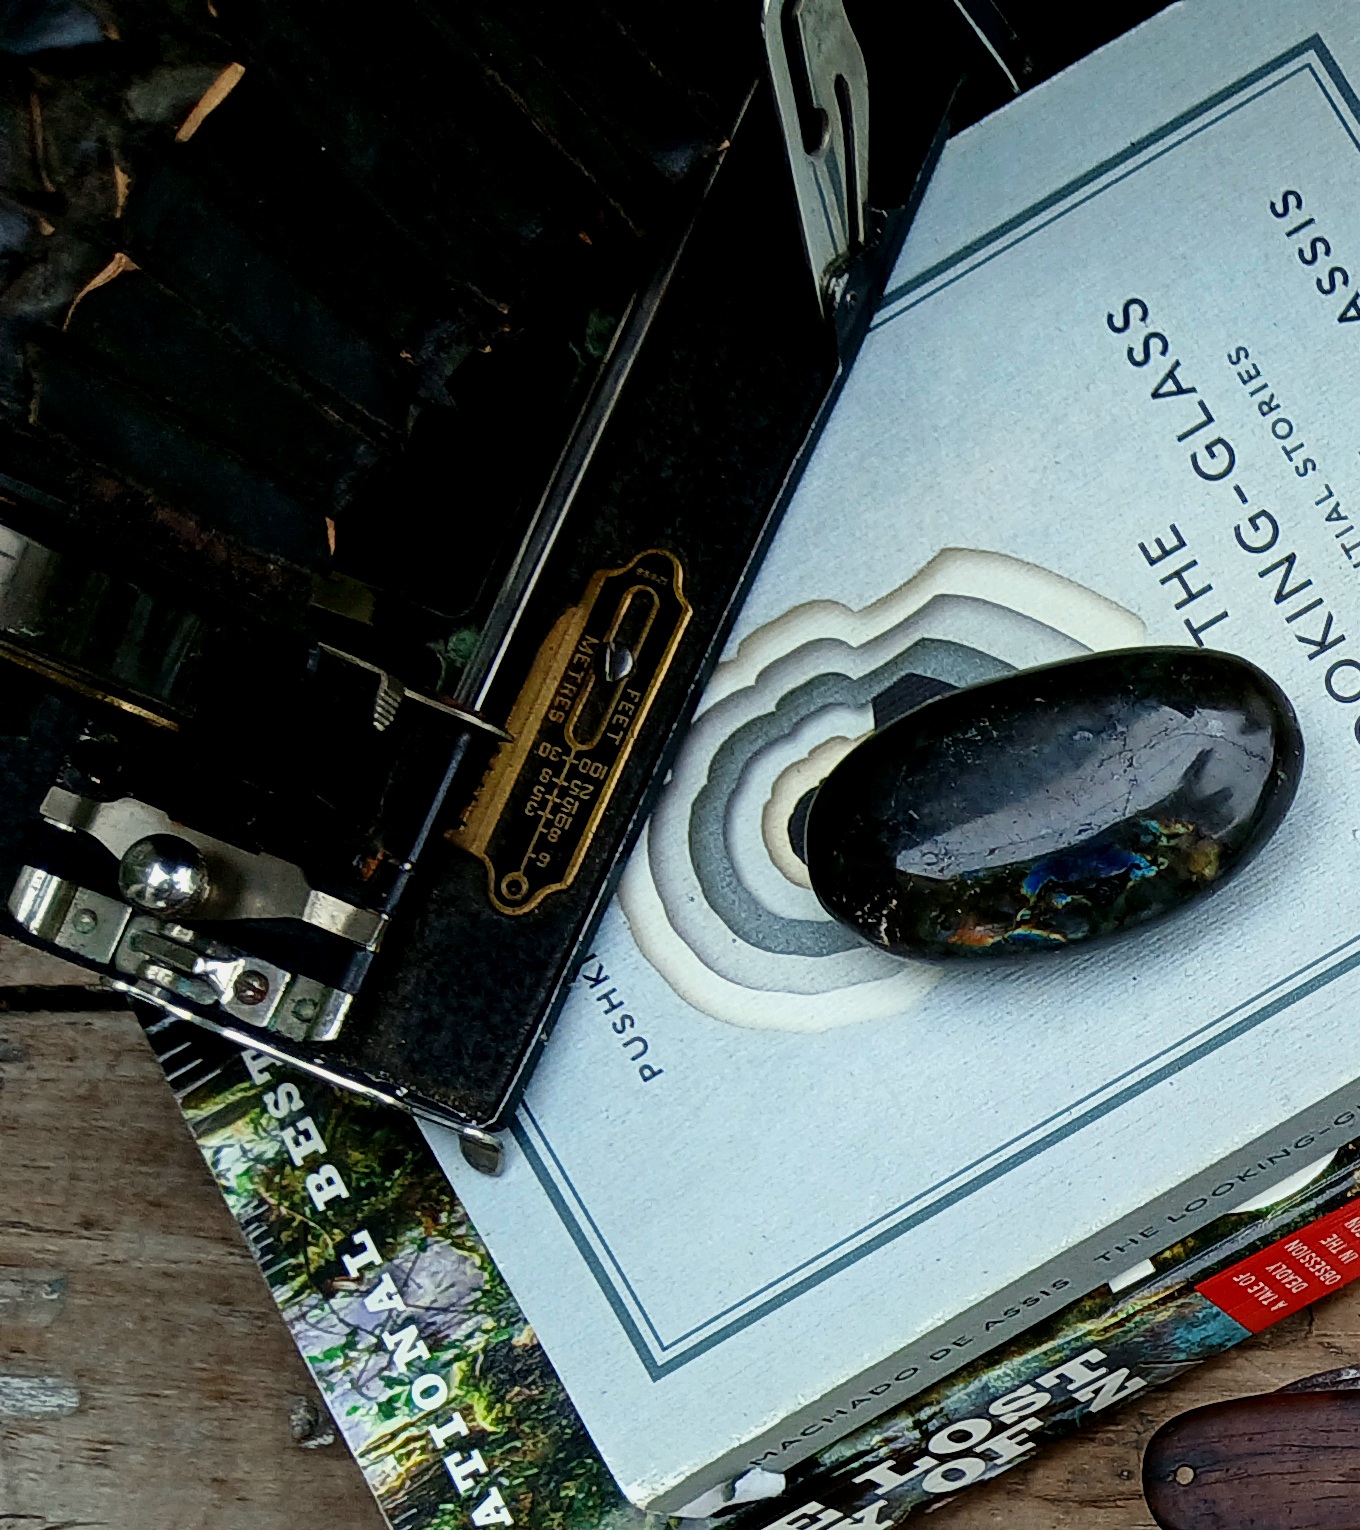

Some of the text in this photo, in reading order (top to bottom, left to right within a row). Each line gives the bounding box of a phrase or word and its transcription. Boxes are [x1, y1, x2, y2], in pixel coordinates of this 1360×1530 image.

[1228, 345, 1318, 478] STORIES
[1138, 523, 1229, 648] THE
[548, 634, 600, 724] METRES
[606, 688, 641, 746] FEET
[582, 953, 664, 1083] PUSHKI
[1265, 1262, 1309, 1294] DEADLY
[1284, 1239, 1342, 1286] OBSESSION
[1319, 1233, 1360, 1265] IN THE
[1233, 1272, 1288, 1312] A TALE OF
[750, 1366, 919, 1468] MACHADO
[928, 1334, 973, 1362] DE
[983, 1277, 1072, 1331] ASSIS
[1093, 1224, 1161, 1264] THE
[852, 1347, 1110, 1495] LOST
[921, 1416, 1047, 1494] OF
